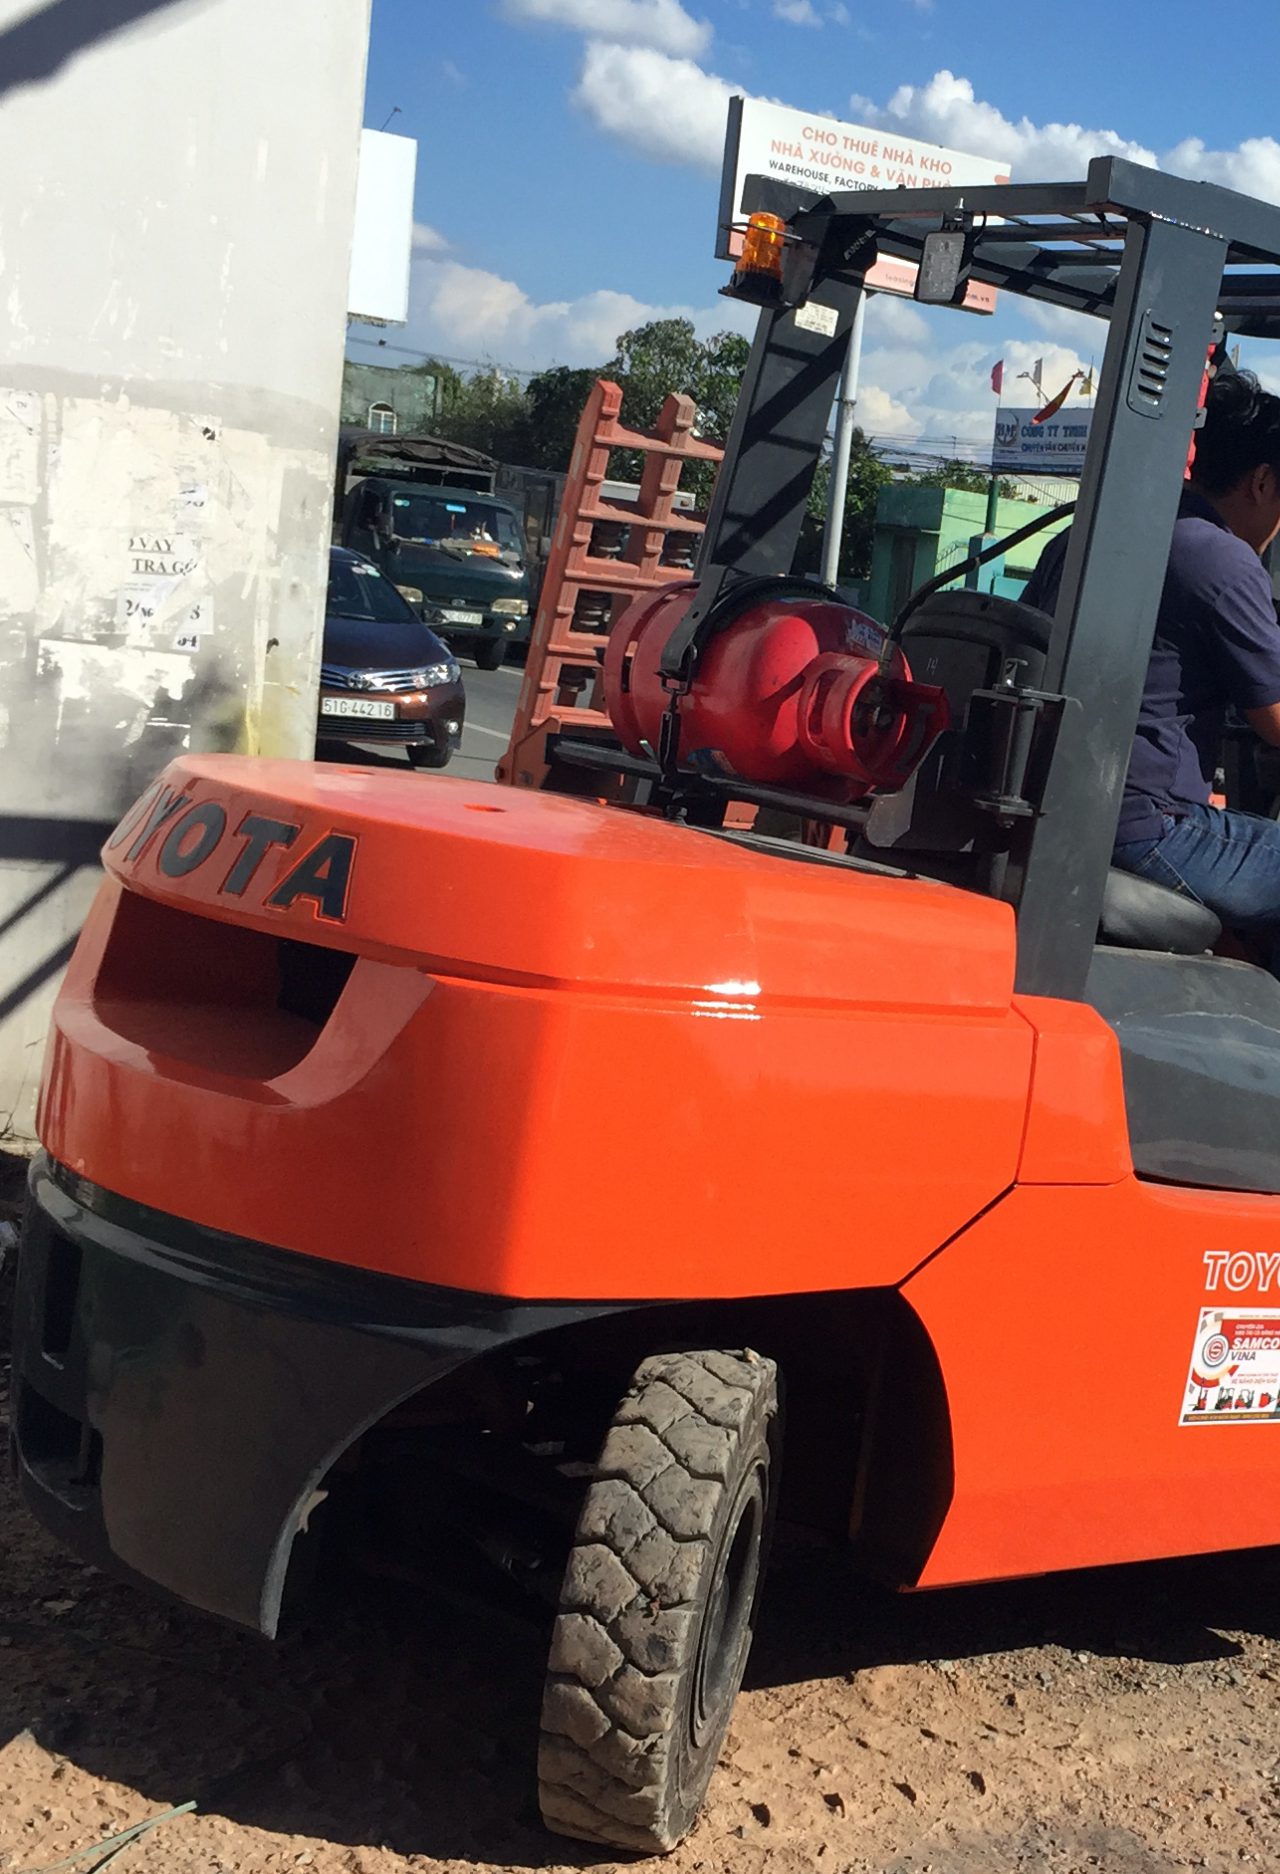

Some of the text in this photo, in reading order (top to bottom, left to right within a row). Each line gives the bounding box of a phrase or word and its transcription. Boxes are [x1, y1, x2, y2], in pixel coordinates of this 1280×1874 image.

[770, 139, 804, 160] NHÀ
[870, 164, 881, 179] &
[802, 126, 953, 176] CHO THUÊ NHÀ KHO
[1230, 1351, 1257, 1361] VINA
